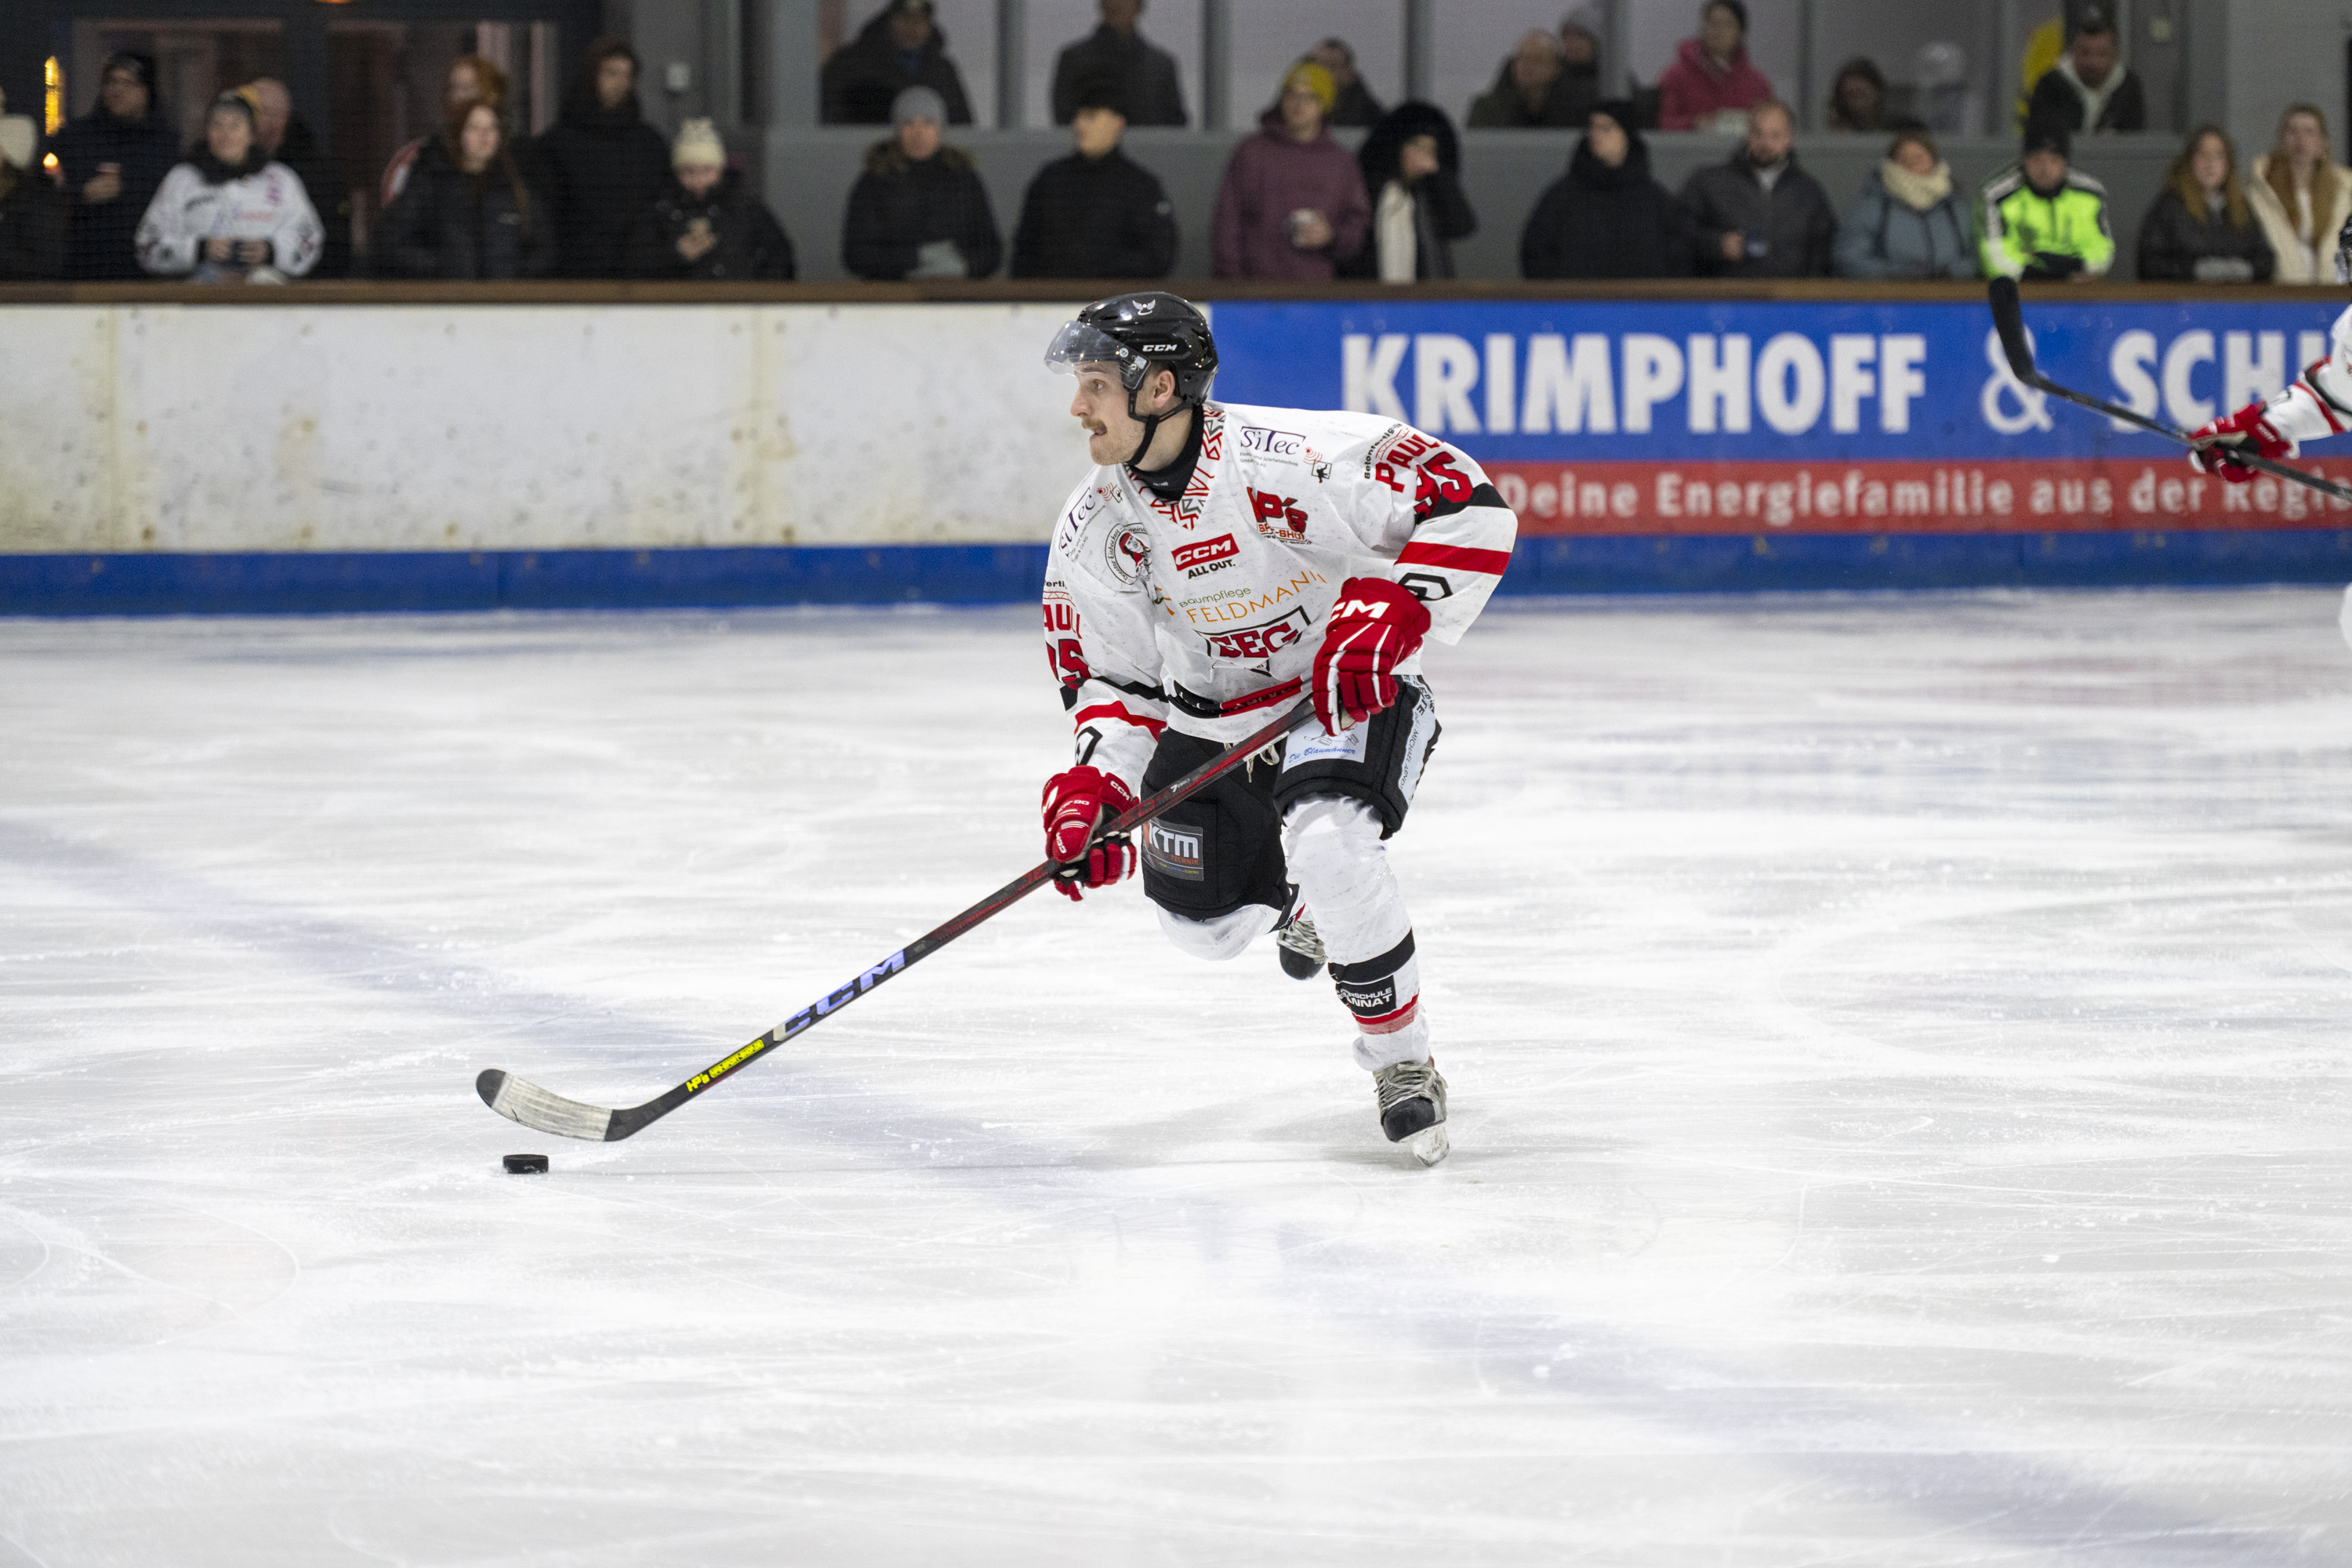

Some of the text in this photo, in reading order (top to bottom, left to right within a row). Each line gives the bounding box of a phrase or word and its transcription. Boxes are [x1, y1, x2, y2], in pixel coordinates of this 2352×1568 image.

[1342, 332, 1926, 434] KRIMPHOFF
[1981, 326, 2053, 434] &
[1494, 472, 1639, 517] Deine
[1657, 469, 2015, 525] Energiefamilie
[2031, 477, 2113, 517] aus
[2130, 469, 2208, 514] der
[1176, 539, 1232, 566] CCM
[1188, 559, 1236, 580] ALL OUT.
[1179, 587, 1251, 608] Baumpflege
[1210, 621, 1298, 659] SEG
[1406, 728, 1419, 763] MICHAEL
[1110, 780, 1131, 801] CCM
[1171, 855, 1199, 866] TECHNIK
[773, 949, 905, 1041] CCM
